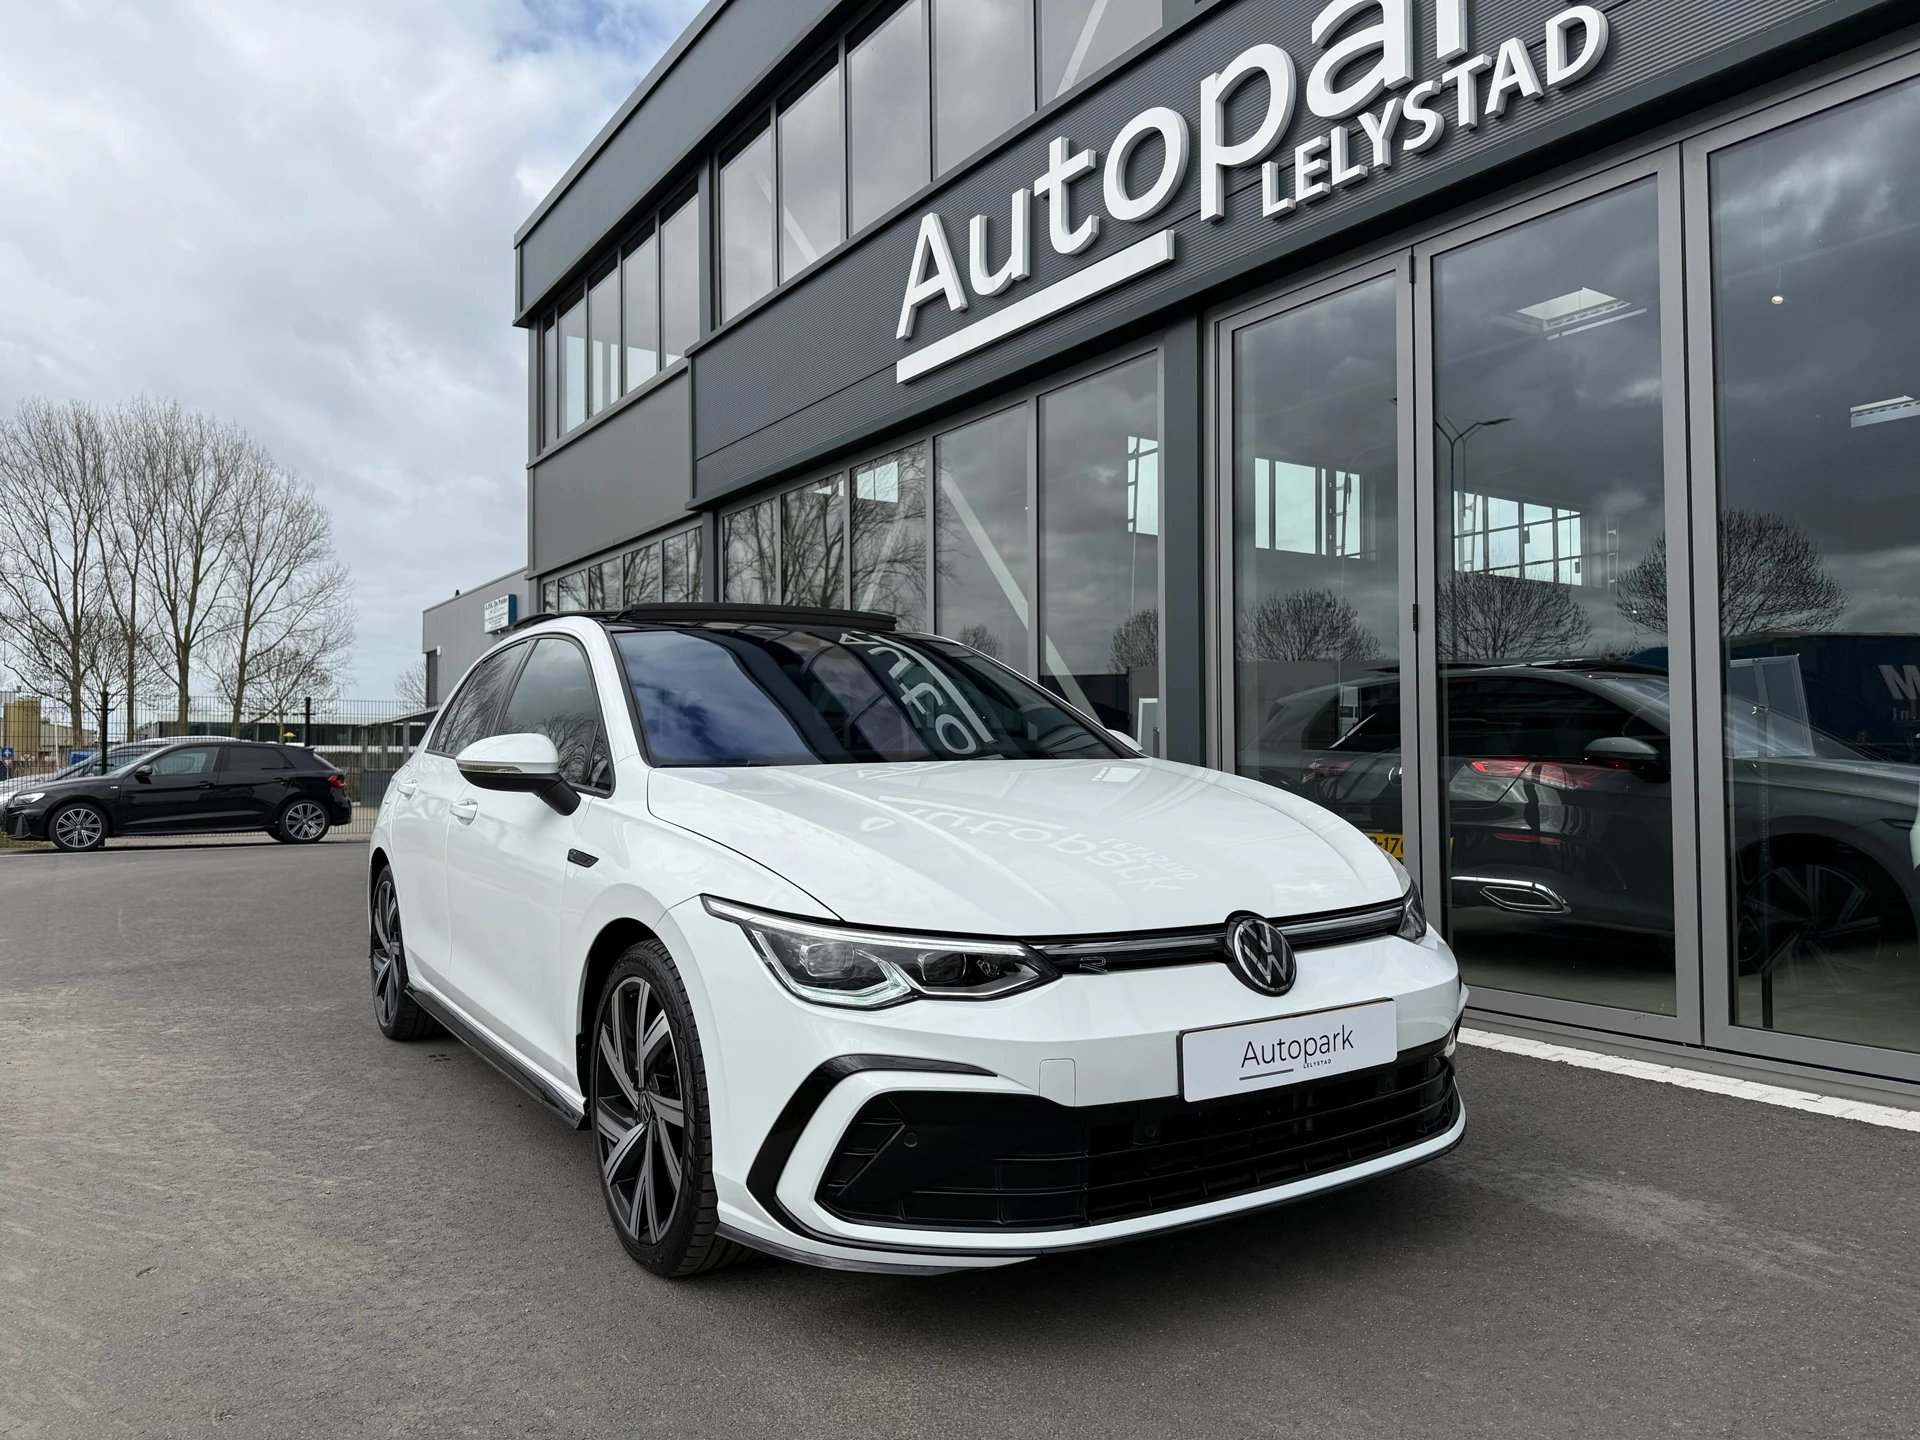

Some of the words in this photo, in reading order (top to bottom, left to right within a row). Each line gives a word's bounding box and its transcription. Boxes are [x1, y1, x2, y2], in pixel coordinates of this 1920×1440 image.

[1261, 5, 1610, 219] LELYSTAD
[1240, 1024, 1354, 1069] Autopark
[1303, 1058, 1332, 1069] LELYSTAD
